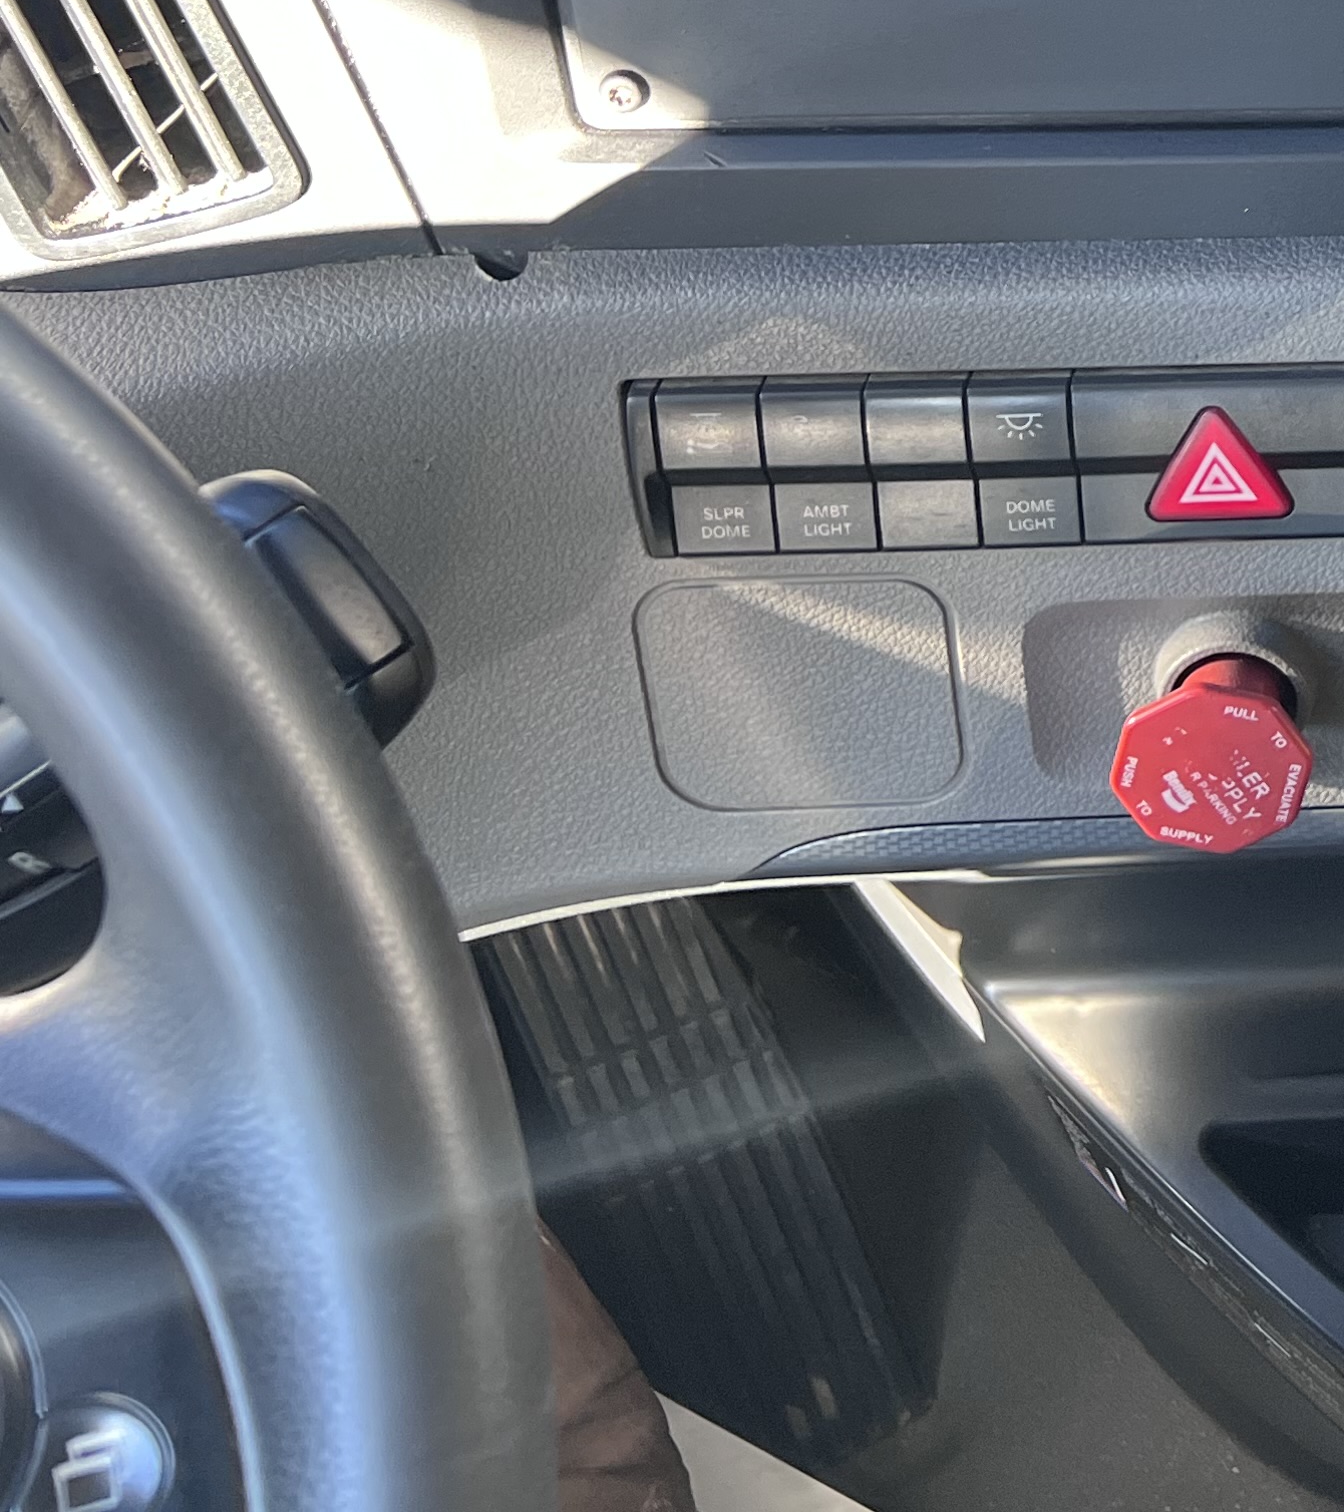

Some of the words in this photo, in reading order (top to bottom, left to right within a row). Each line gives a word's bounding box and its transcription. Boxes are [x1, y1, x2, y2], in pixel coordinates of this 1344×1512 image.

[703, 506, 745, 521] SLPR
[803, 504, 850, 518] AMBT
[1006, 499, 1056, 514] DOME
[701, 524, 751, 539] DOME
[803, 522, 853, 537] LIGHT
[1008, 517, 1057, 532] LIGHT
[1223, 705, 1259, 722] PULL
[1270, 731, 1288, 749] TO
[1120, 755, 1139, 788] PUSH
[1136, 799, 1153, 817] TO
[1160, 825, 1214, 845] SUPPLY
[1275, 763, 1302, 824] EVACUATE
